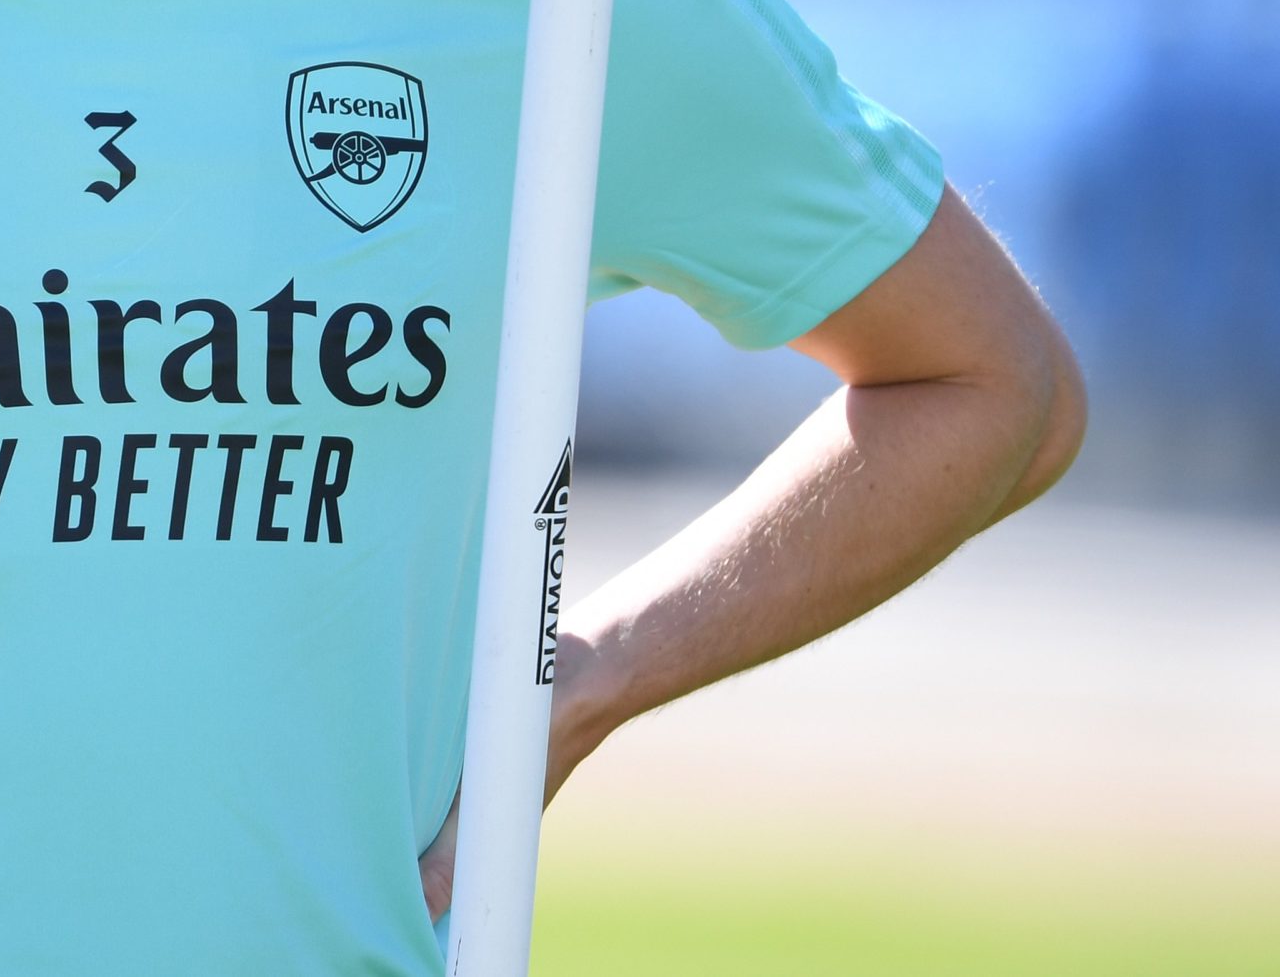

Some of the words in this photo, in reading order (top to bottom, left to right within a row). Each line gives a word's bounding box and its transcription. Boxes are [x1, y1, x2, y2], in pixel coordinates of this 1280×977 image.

[83, 110, 138, 203] 3
[307, 90, 408, 121] Arsenal
[52, 433, 354, 544] BETTER
[541, 484, 569, 686] DIAMOND
